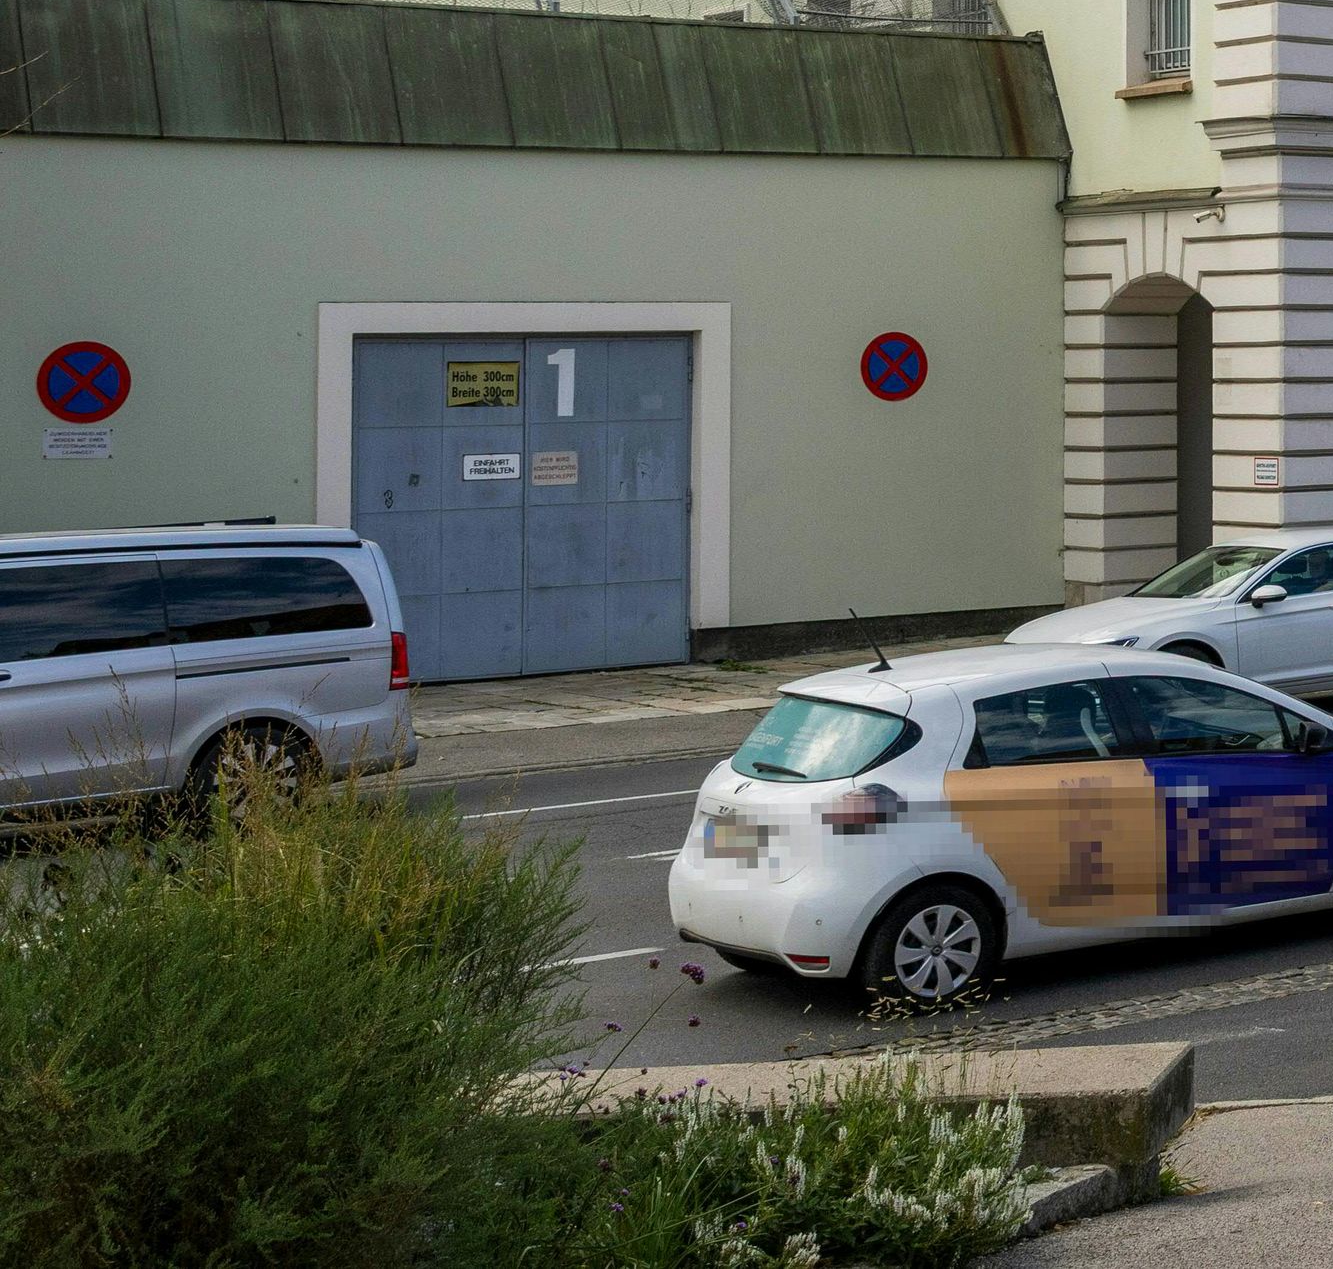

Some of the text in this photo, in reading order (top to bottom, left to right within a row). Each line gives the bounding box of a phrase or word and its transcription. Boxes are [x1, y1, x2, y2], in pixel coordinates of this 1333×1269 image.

[451, 371, 514, 383] Höhe 300cm
[547, 348, 576, 417] 1
[451, 386, 514, 398] Breite 300cm
[473, 458, 511, 467] EINFAHRT
[469, 466, 515, 475] FREIHALTEN
